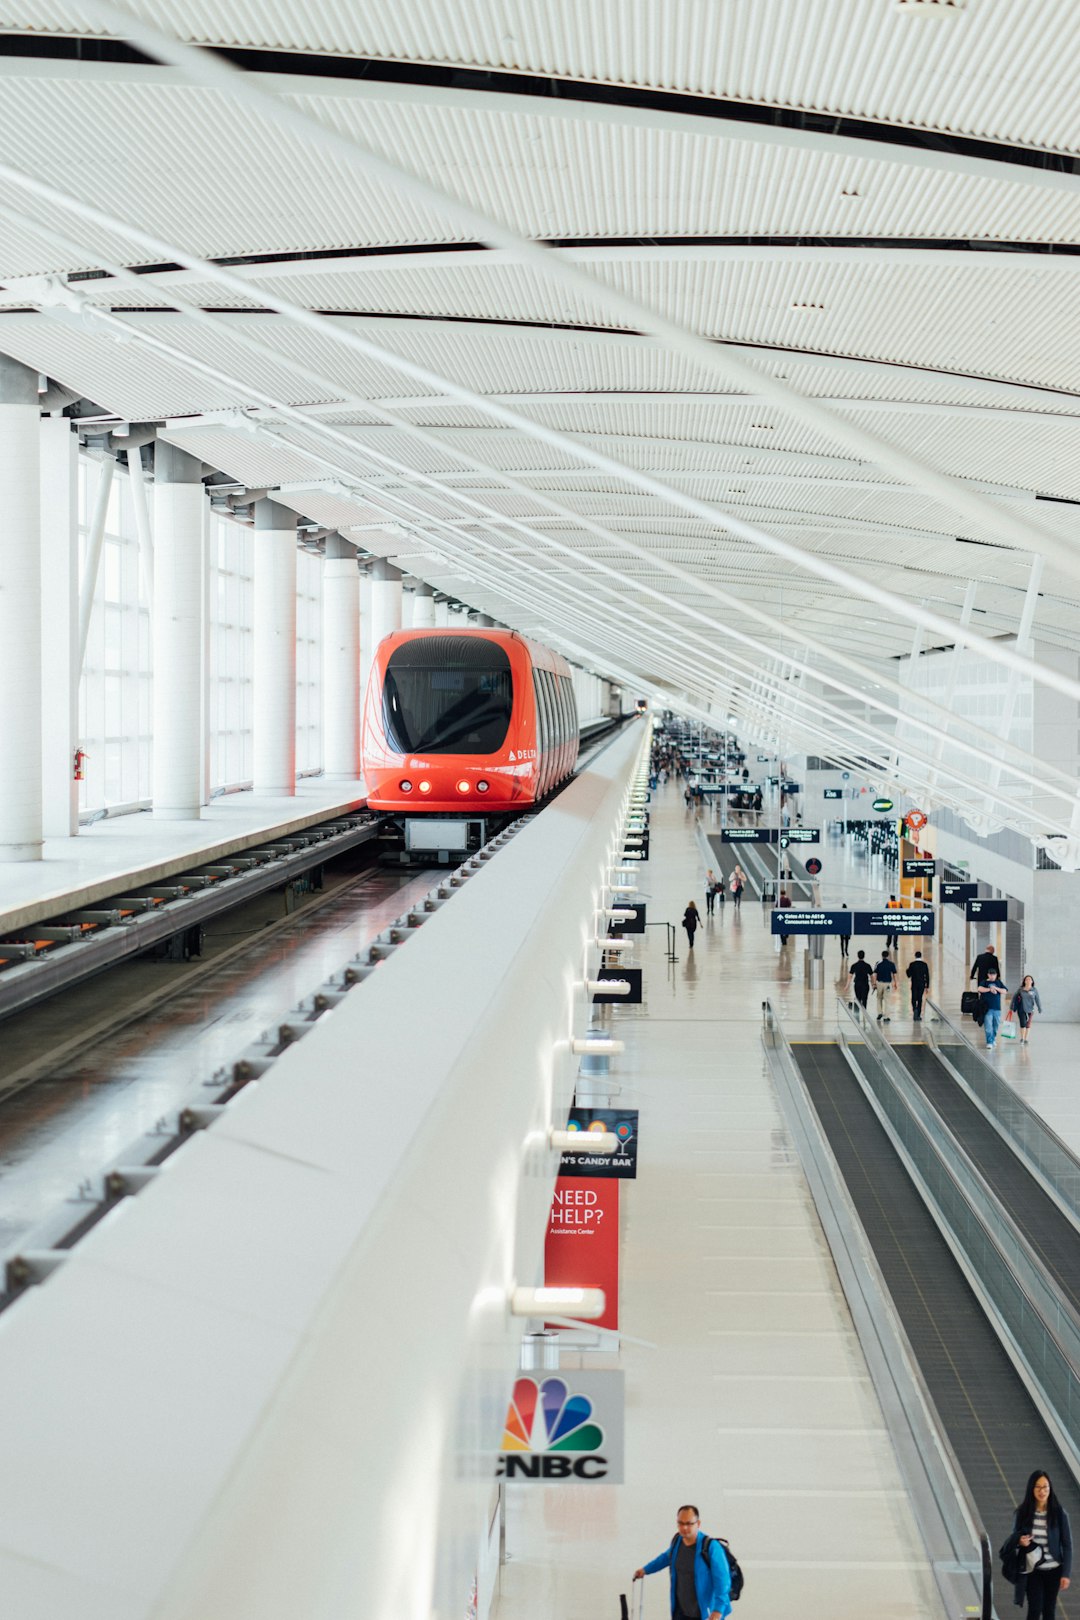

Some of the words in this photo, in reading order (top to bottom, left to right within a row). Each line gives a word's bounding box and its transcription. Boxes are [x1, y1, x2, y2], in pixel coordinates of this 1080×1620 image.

[517, 750, 536, 759] DELTA
[560, 1156, 576, 1164] N'S
[577, 1157, 610, 1165] CANDY
[552, 1190, 598, 1205] NEED
[551, 1209, 604, 1224] HELP?
[496, 1454, 608, 1479] NBC
